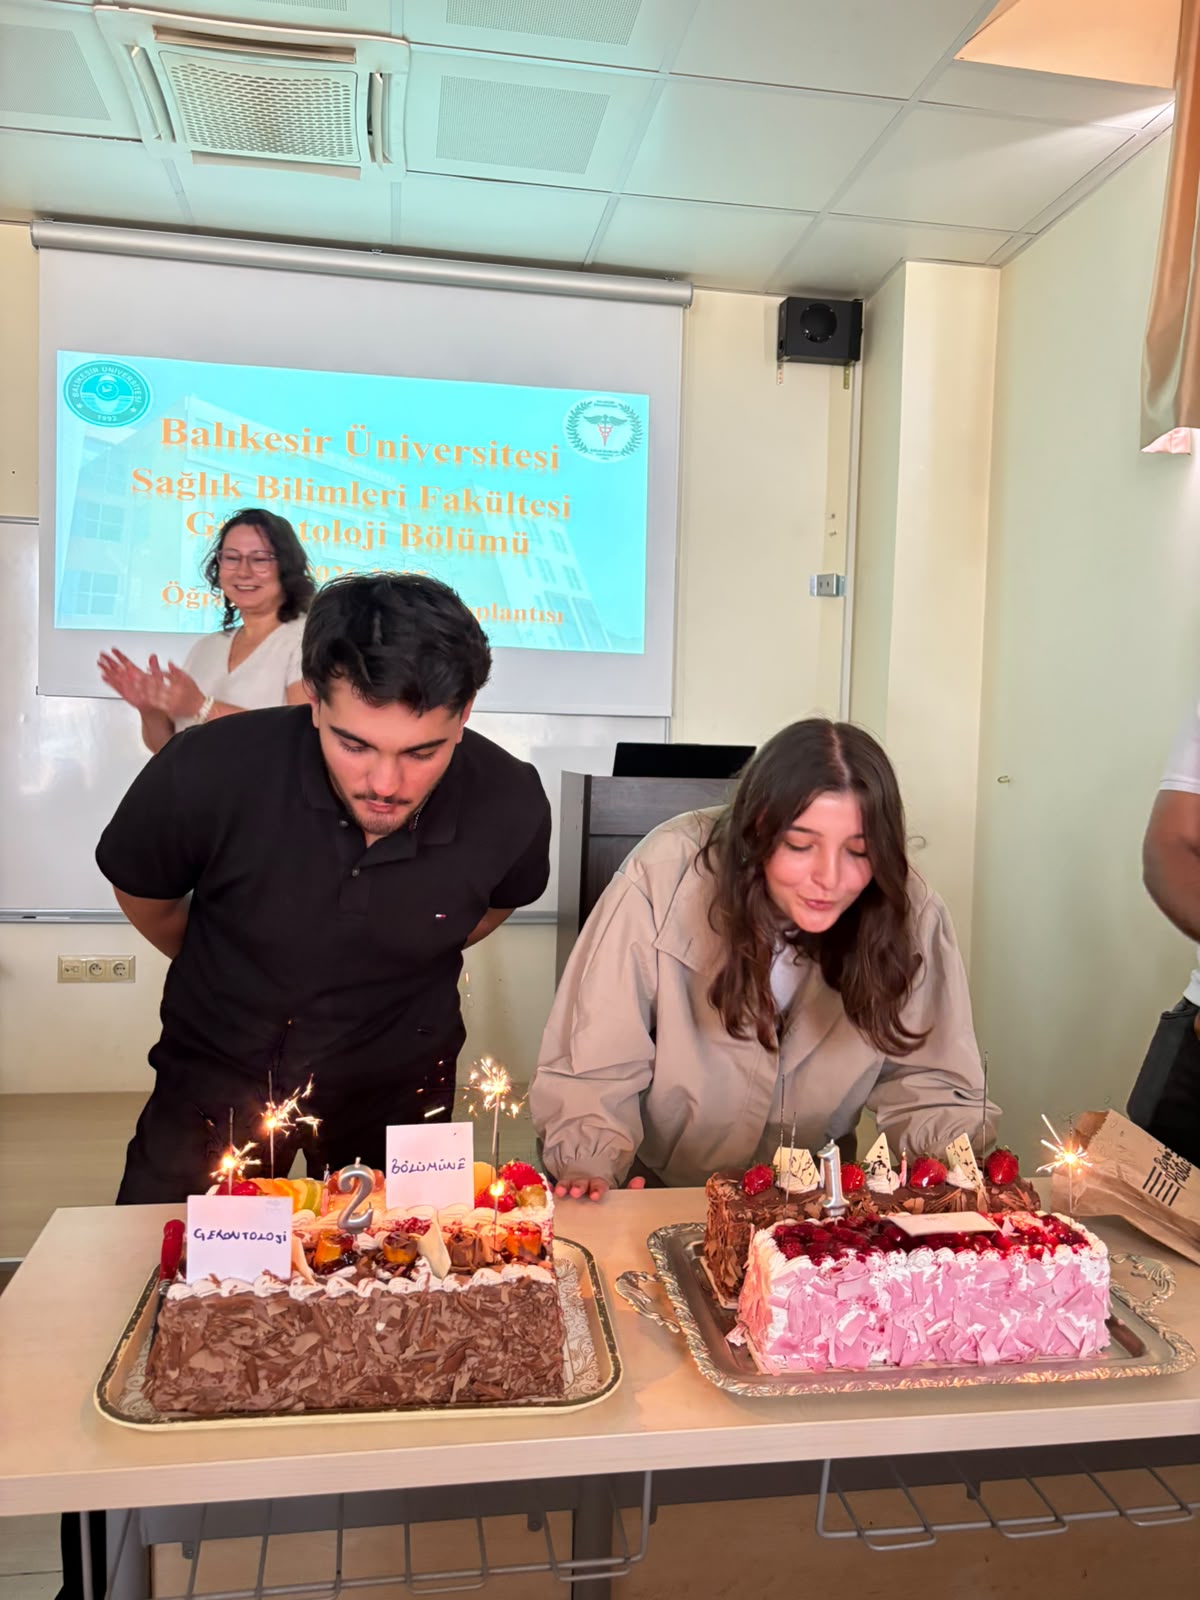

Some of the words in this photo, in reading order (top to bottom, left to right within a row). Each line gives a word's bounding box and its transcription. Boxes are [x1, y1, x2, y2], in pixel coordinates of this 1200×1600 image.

[160, 417, 332, 455] Balıkesir
[345, 424, 560, 470] Üniversitesi
[131, 468, 242, 500] Sağlık
[256, 475, 406, 509] Bilimleri
[419, 485, 571, 518] Fakültesi
[186, 511, 386, 550] Gtoloji
[400, 523, 529, 554] Bölümü
[470, 602, 563, 624] plantısı
